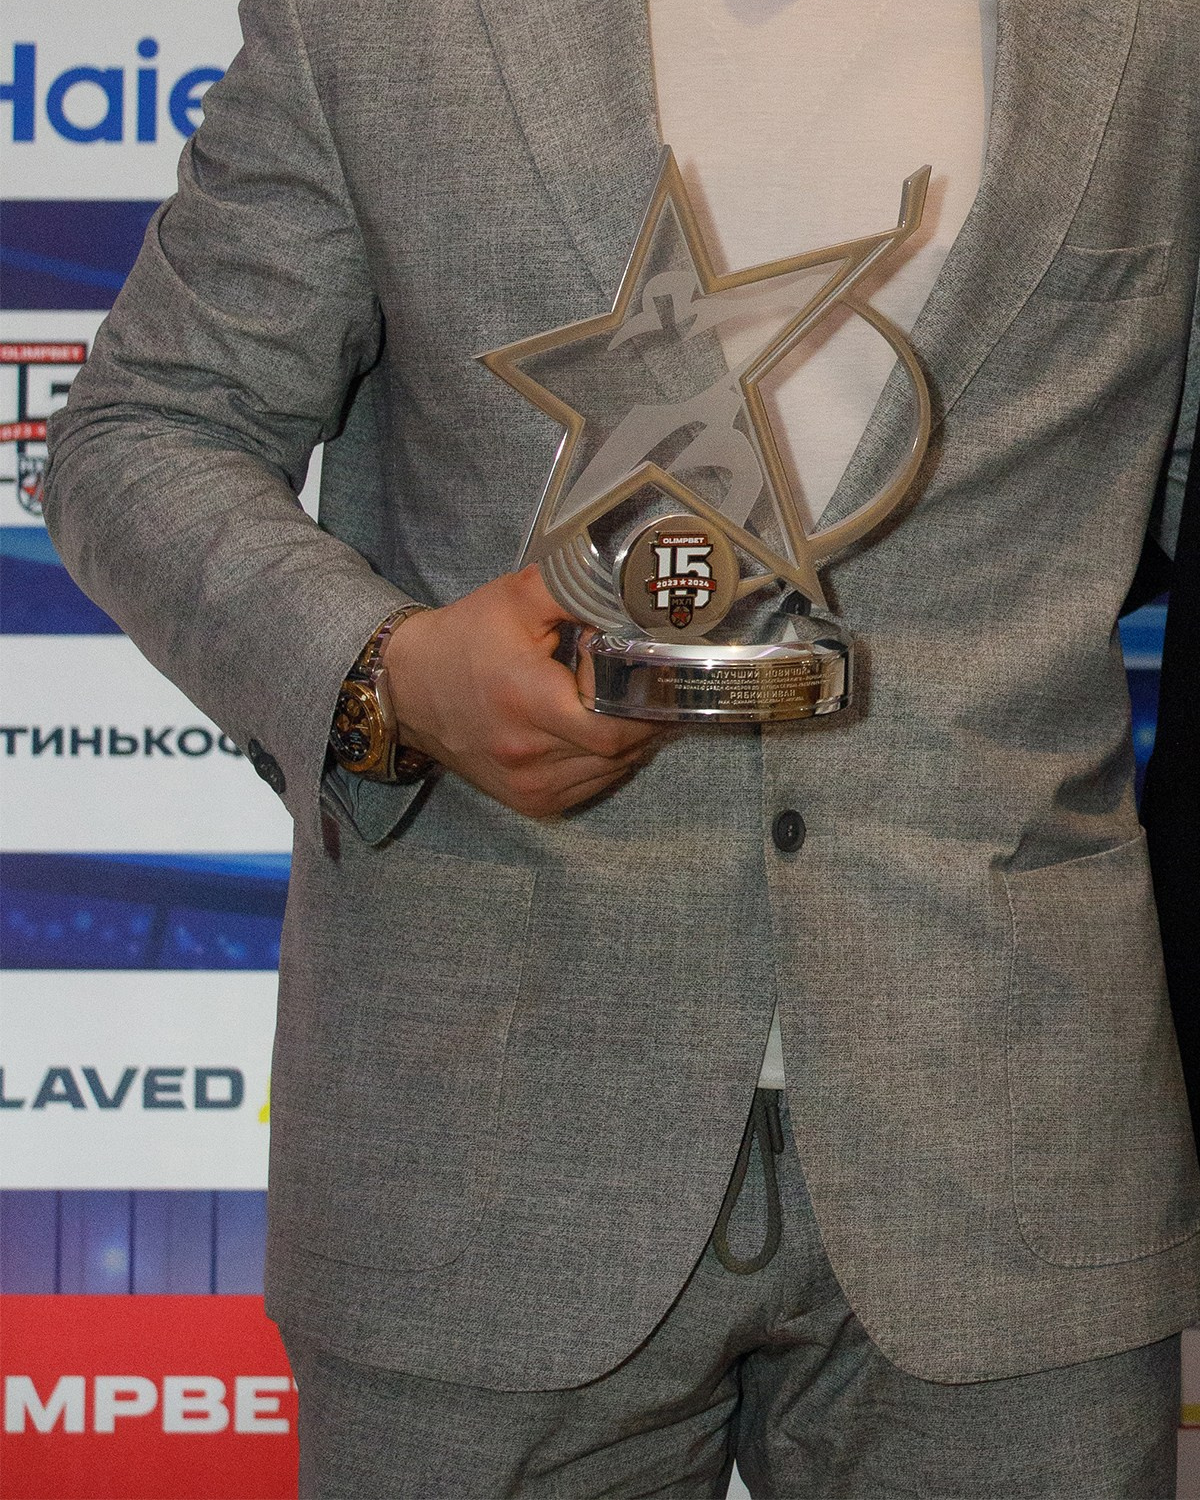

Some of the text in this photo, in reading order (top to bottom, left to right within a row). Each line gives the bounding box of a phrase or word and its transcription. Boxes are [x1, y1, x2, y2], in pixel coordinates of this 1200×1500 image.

[654, 547, 712, 607] 15
[656, 579, 710, 588] 2023 2024
[5, 1375, 298, 1434] MPBE
